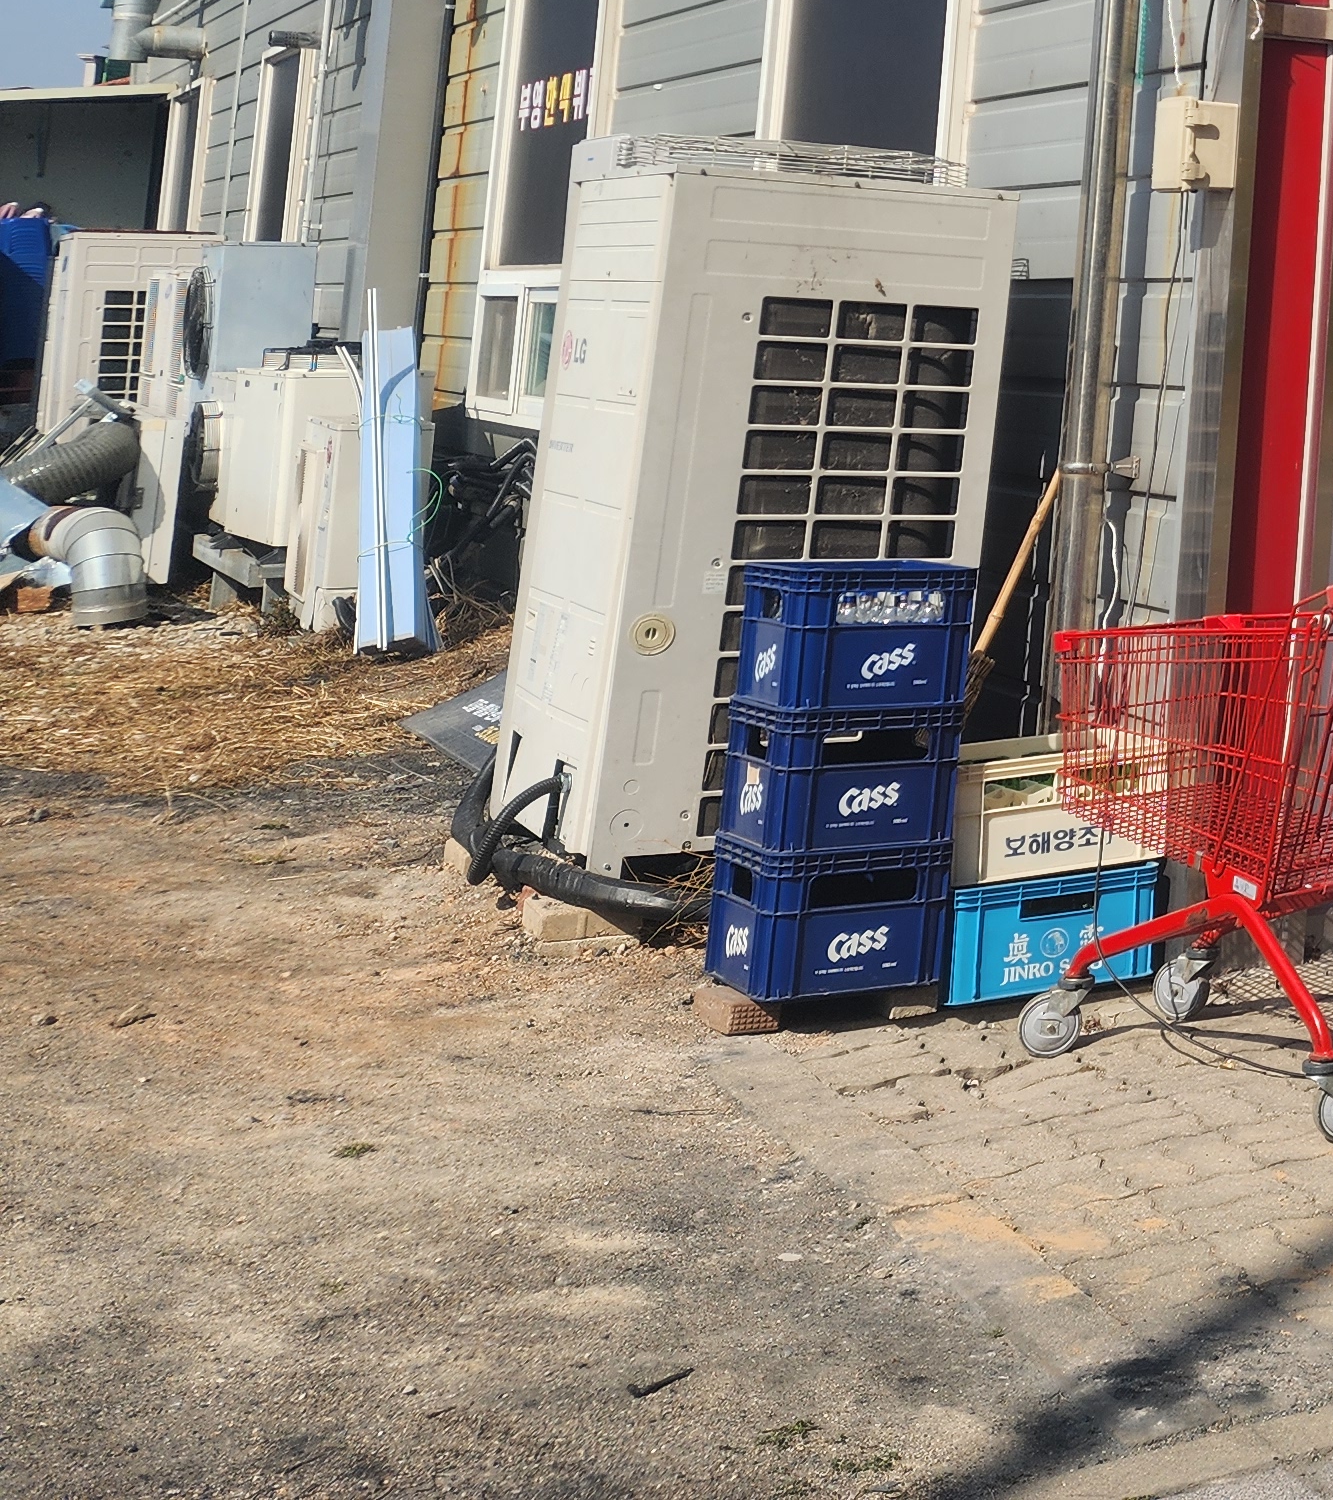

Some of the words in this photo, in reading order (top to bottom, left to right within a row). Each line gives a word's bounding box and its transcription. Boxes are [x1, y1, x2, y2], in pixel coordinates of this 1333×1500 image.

[573, 338, 587, 364] LG
[861, 642, 917, 680] Cass
[838, 781, 902, 818] Cass
[827, 925, 891, 963] Cass
[1000, 961, 1054, 987] JINRO
